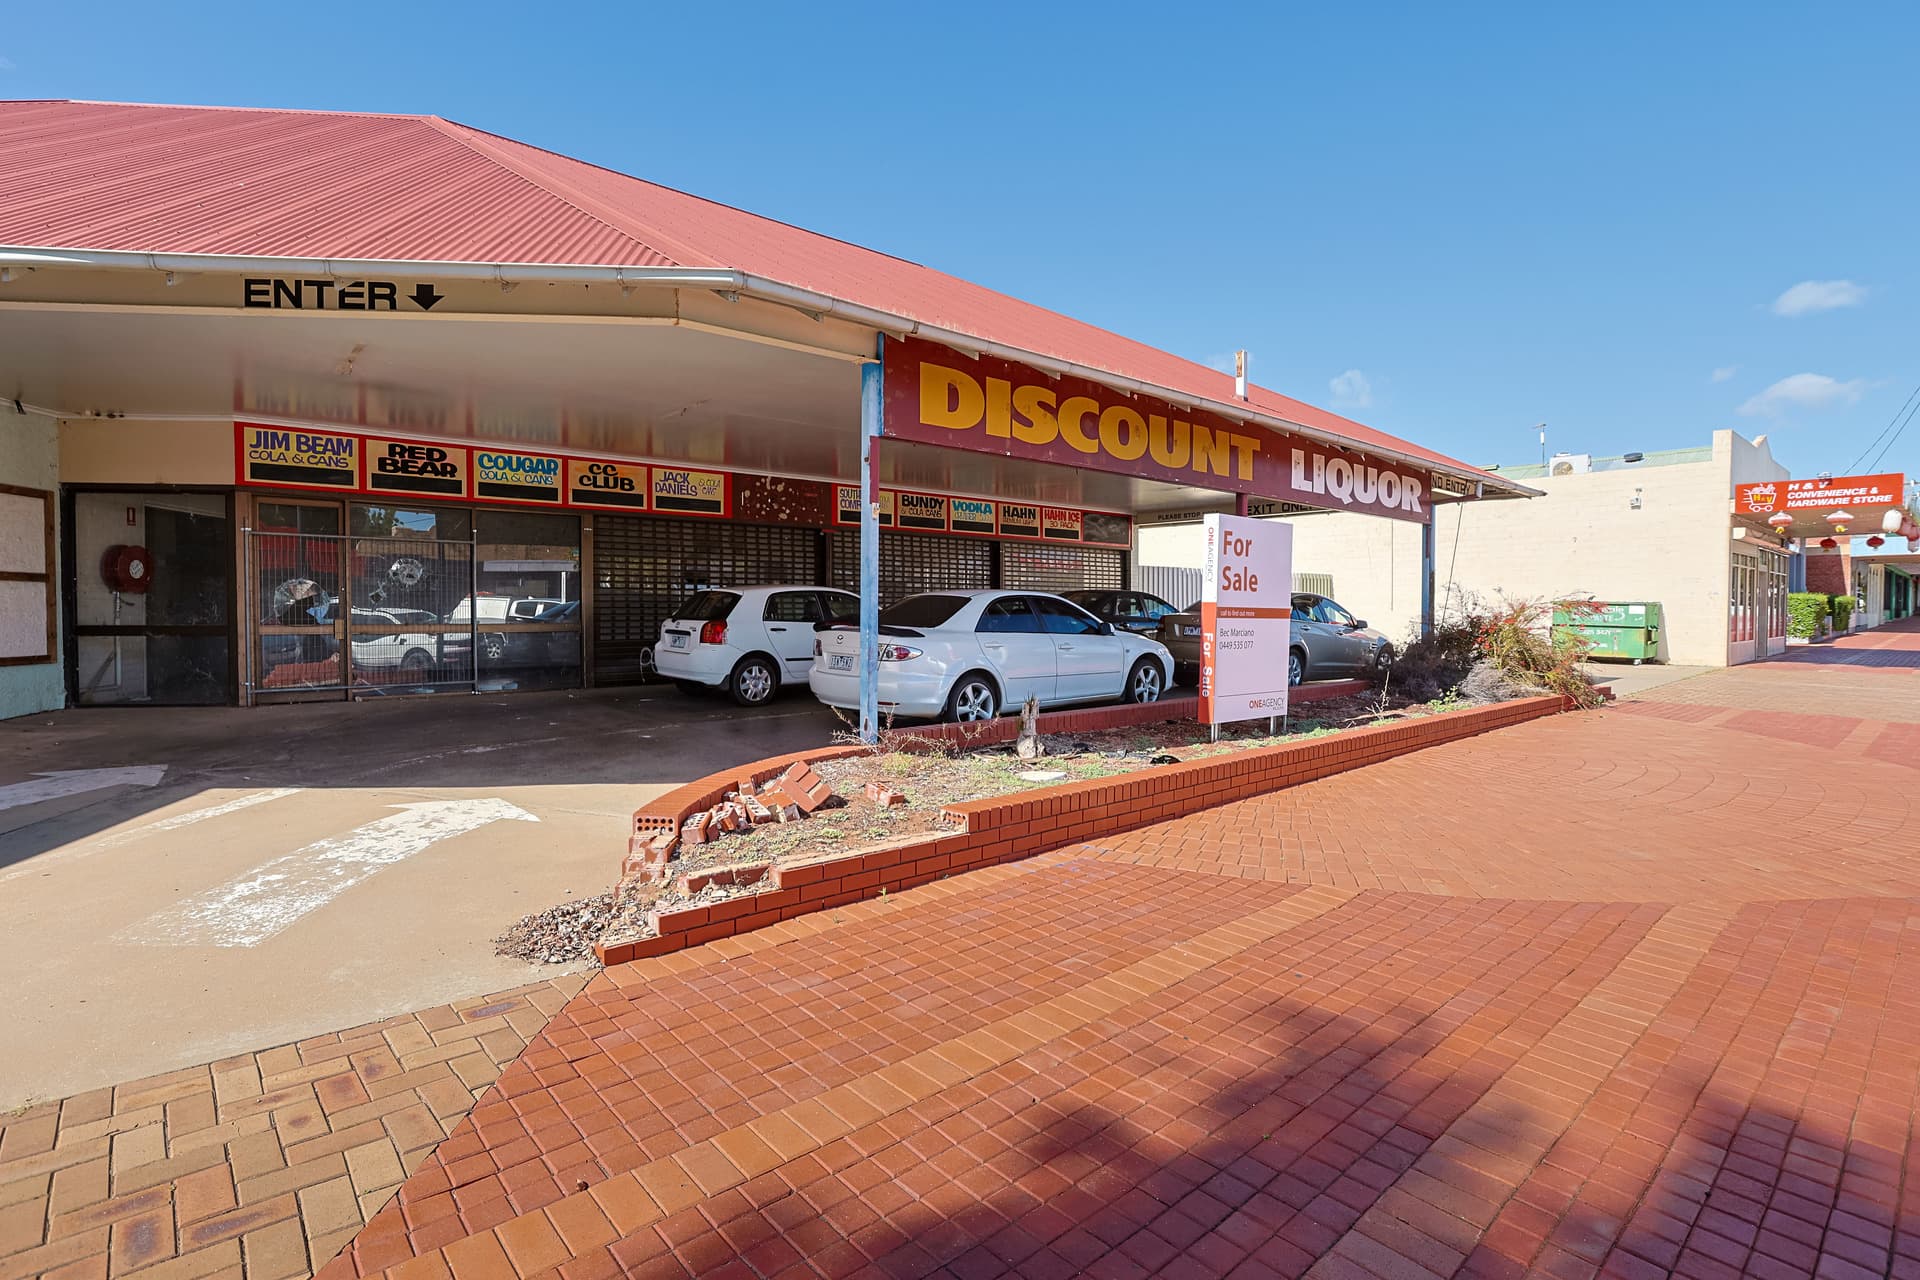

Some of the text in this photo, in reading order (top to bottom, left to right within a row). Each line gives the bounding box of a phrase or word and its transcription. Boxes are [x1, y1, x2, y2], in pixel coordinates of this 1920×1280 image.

[244, 279, 397, 310] ENTER
[250, 431, 353, 457] JIM BEAM
[919, 361, 1423, 513] DISCOUNT LIQUOR
[250, 450, 349, 468] COLA & CANS
[388, 443, 447, 462] RED
[377, 457, 458, 478] BEAR
[478, 453, 558, 475] COUGAR
[588, 463, 618, 476] CC
[480, 470, 554, 485] COLA & CANS
[579, 475, 635, 491] CLUB
[659, 471, 690, 484] JACK
[1432, 474, 1442, 488] NO
[655, 482, 698, 496] DANIELS
[1787, 487, 1867, 499] CONVENIENCE
[1788, 483, 1799, 491] H
[901, 494, 945, 509] BUNDY
[952, 500, 992, 514] VODKA
[1787, 494, 1893, 508] HARDWARE STORE
[1003, 505, 1036, 519] HAHN
[1044, 509, 1080, 522] HAHN ICE
[1248, 503, 1275, 516] EXIT
[1049, 520, 1058, 528] 30
[1157, 513, 1181, 521] PLEASE
[1223, 531, 1252, 557] For
[1222, 565, 1258, 592] Sale
[1220, 628, 1254, 637] Bec Marciano
[1203, 632, 1213, 658] For
[1244, 641, 1254, 649] 077
[1202, 665, 1213, 698] Sale
[1249, 697, 1285, 708] ONEAGENCY
